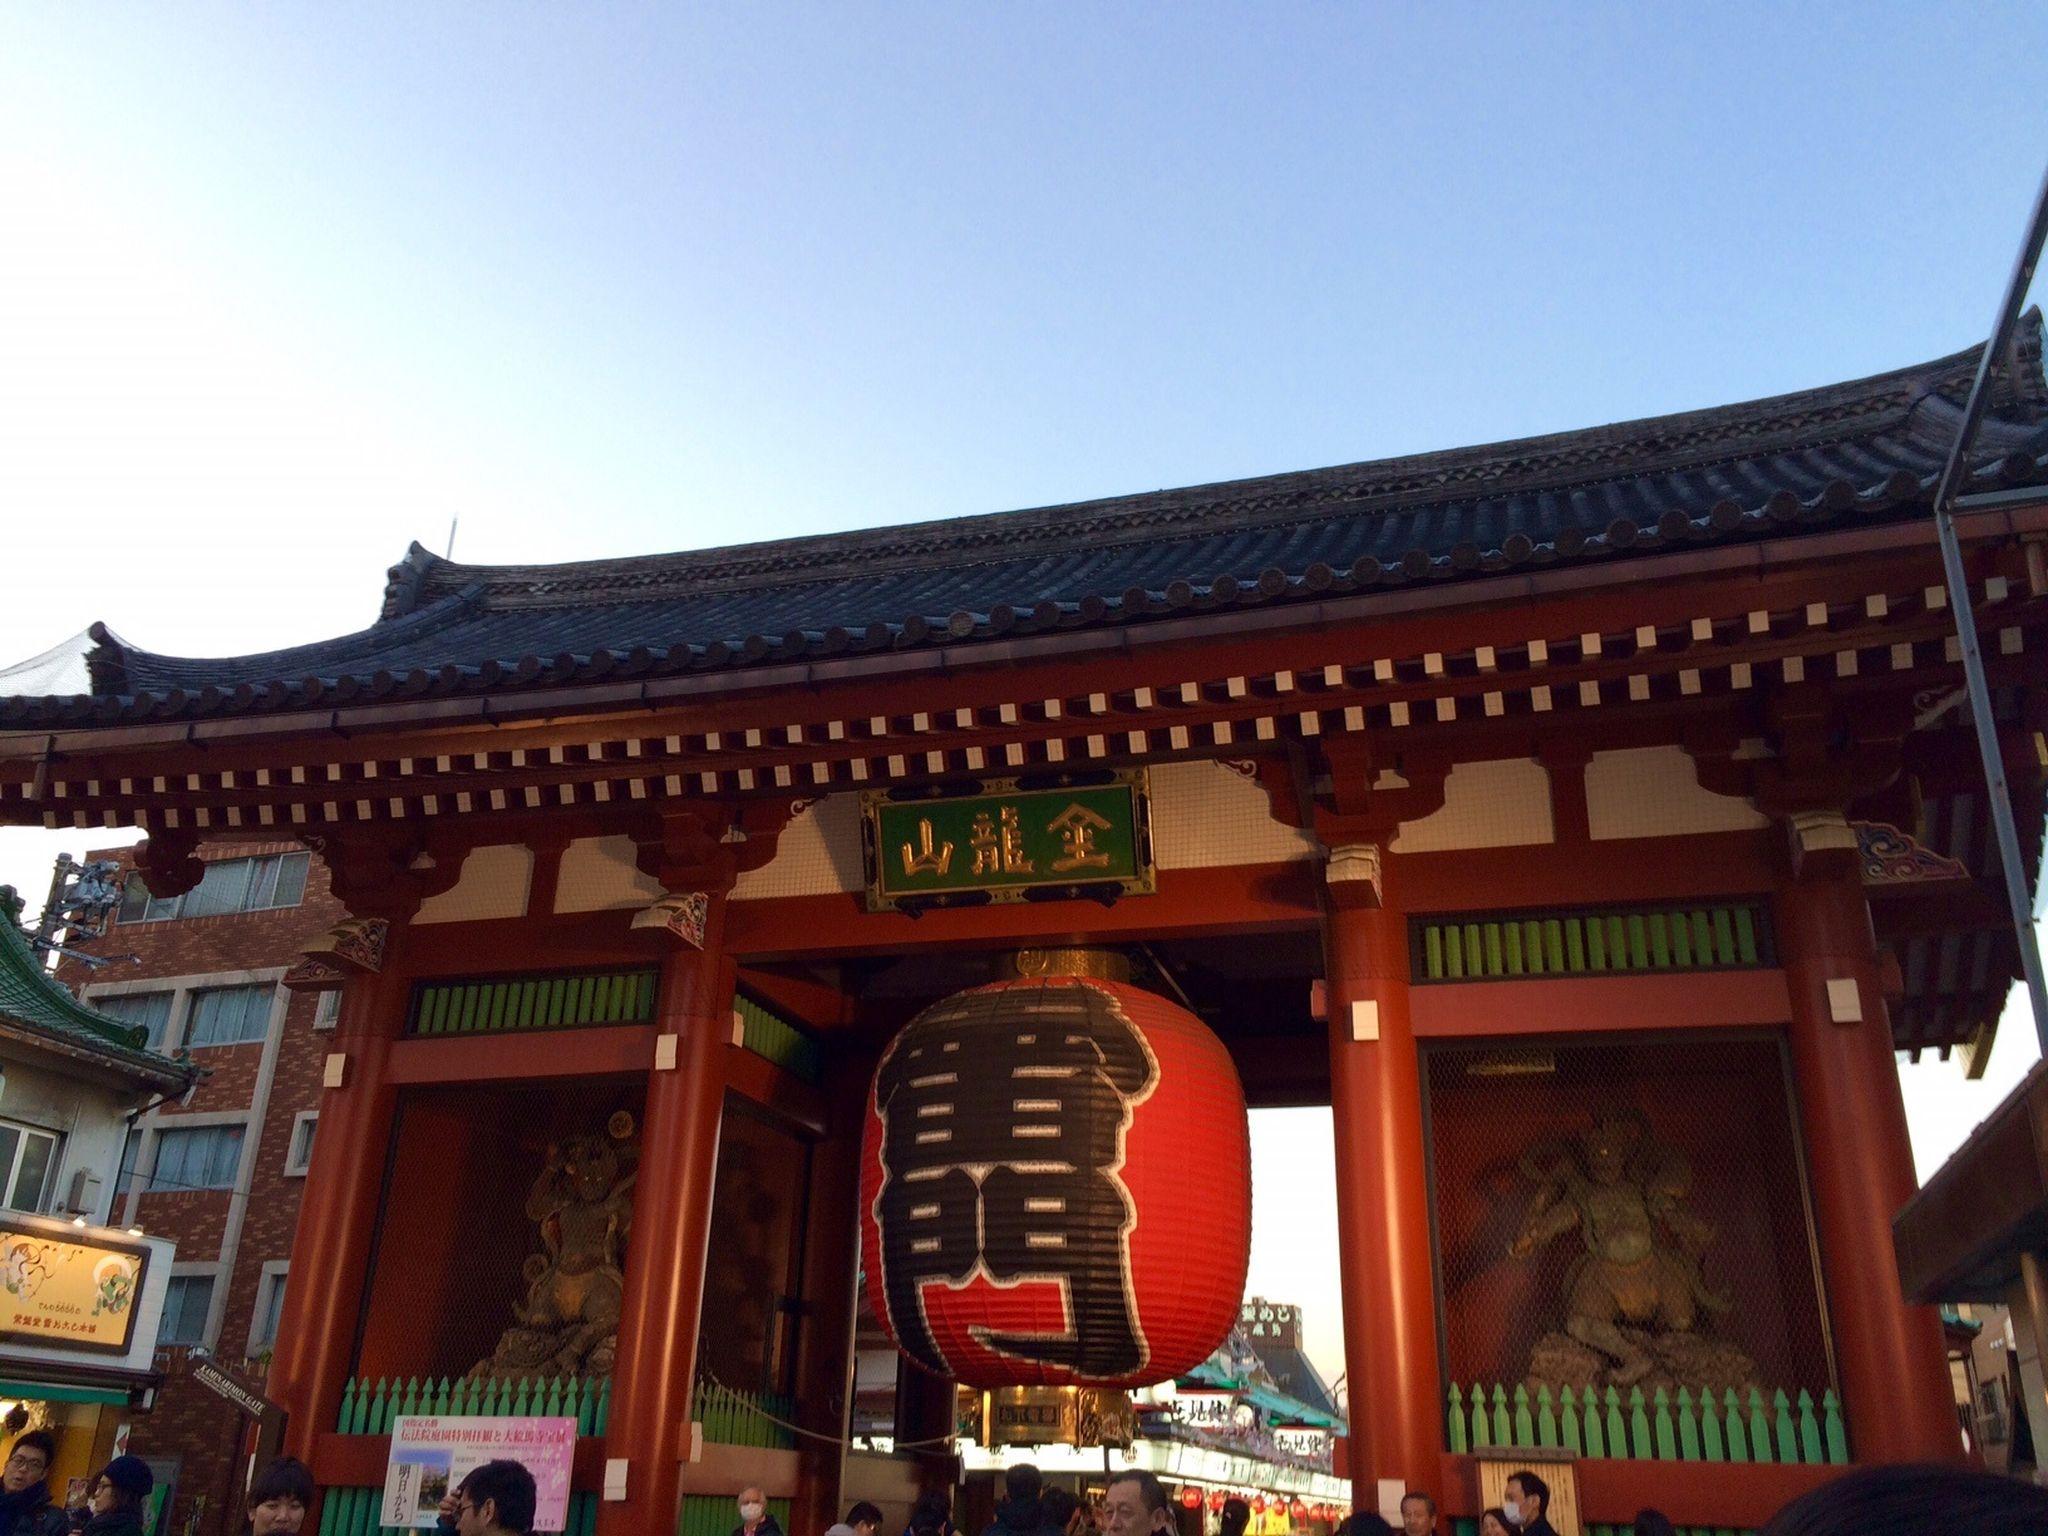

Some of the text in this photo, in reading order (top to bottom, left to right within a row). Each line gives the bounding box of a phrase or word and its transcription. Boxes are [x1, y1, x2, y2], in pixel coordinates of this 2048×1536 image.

[901, 803, 1112, 878] 金龍山
[874, 983, 1161, 1382] 雷門
[199, 1364, 247, 1400] KAMINARIMON
[245, 1395, 266, 1413] GATE
[394, 1464, 411, 1521] 明日から
